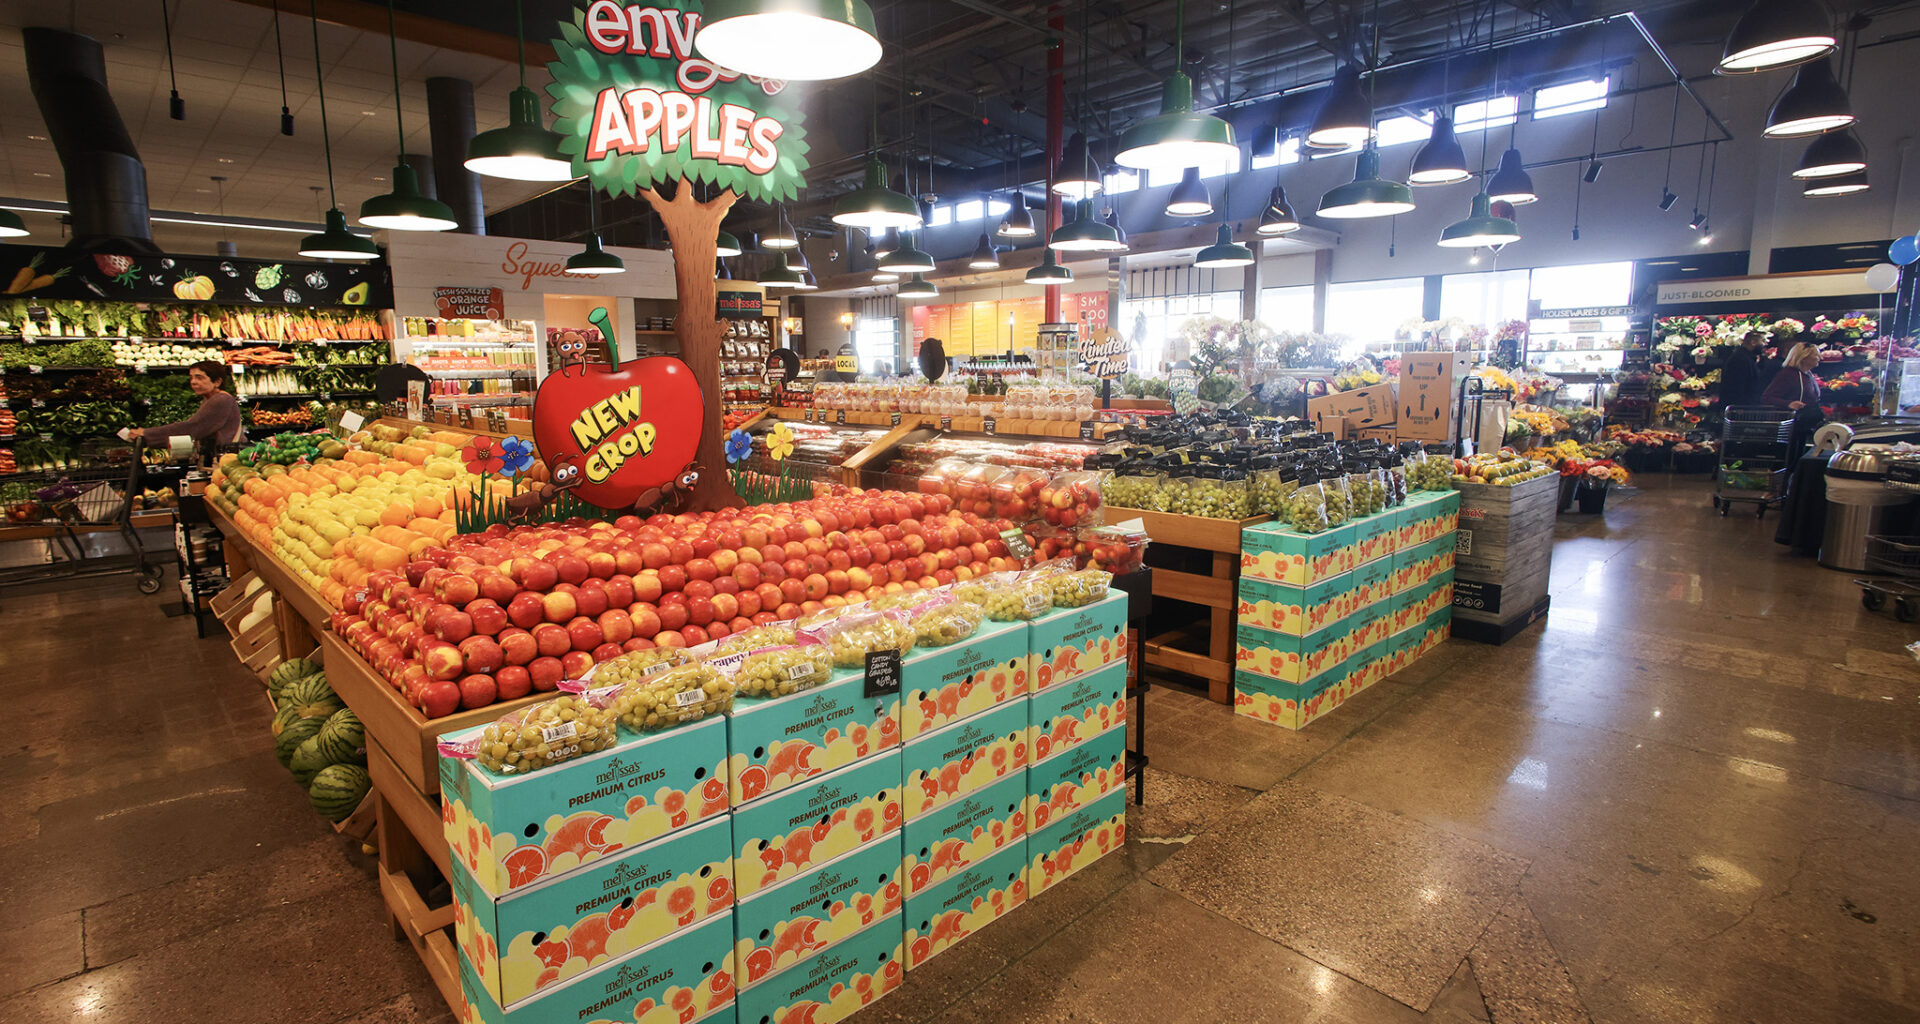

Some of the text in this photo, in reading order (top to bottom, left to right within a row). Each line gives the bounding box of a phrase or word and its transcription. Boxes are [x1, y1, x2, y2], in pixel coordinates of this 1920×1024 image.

[585, 0, 741, 93] env
[585, 88, 784, 176] APPLES
[450, 295, 490, 304] ORANGE
[720, 297, 761, 309] melissa's
[1662, 288, 1751, 300] JUST-BLOOMED
[456, 305, 487, 315] JUICE
[1542, 309, 1598, 319] HOUSEWARES
[1608, 307, 1635, 316] GIFTS
[795, 320, 802, 332] 2
[837, 360, 856, 368] LOCAL
[1079, 337, 1133, 364] Limited
[1094, 358, 1128, 377] Time
[570, 384, 642, 456] NEW
[585, 422, 656, 484] CROP
[705, 652, 744, 668] rapery
[871, 662, 889, 670] CANDY
[872, 655, 891, 663] COTTON
[942, 658, 995, 682] PREMIUM CITRUS
[785, 706, 854, 735] PREMIUM CITRUS
[943, 733, 995, 760] PREMIUM CITRUS
[596, 761, 642, 785] melissa's
[568, 768, 666, 808] PREMIUM CITRUS
[789, 793, 858, 827] PREMIUM CITRUS
[943, 806, 994, 836] PREMIUM CITRUS
[603, 864, 647, 890] melissa's
[576, 869, 673, 914] PREMIUM CITRUS
[790, 877, 859, 915] PREMIUM CITRUS
[943, 876, 994, 909] PREMIUM CITRUS
[605, 965, 649, 994] melissa's
[789, 957, 858, 1000] PREMIUM CITRUS
[579, 968, 674, 1019] PREMIUM CITRUS
